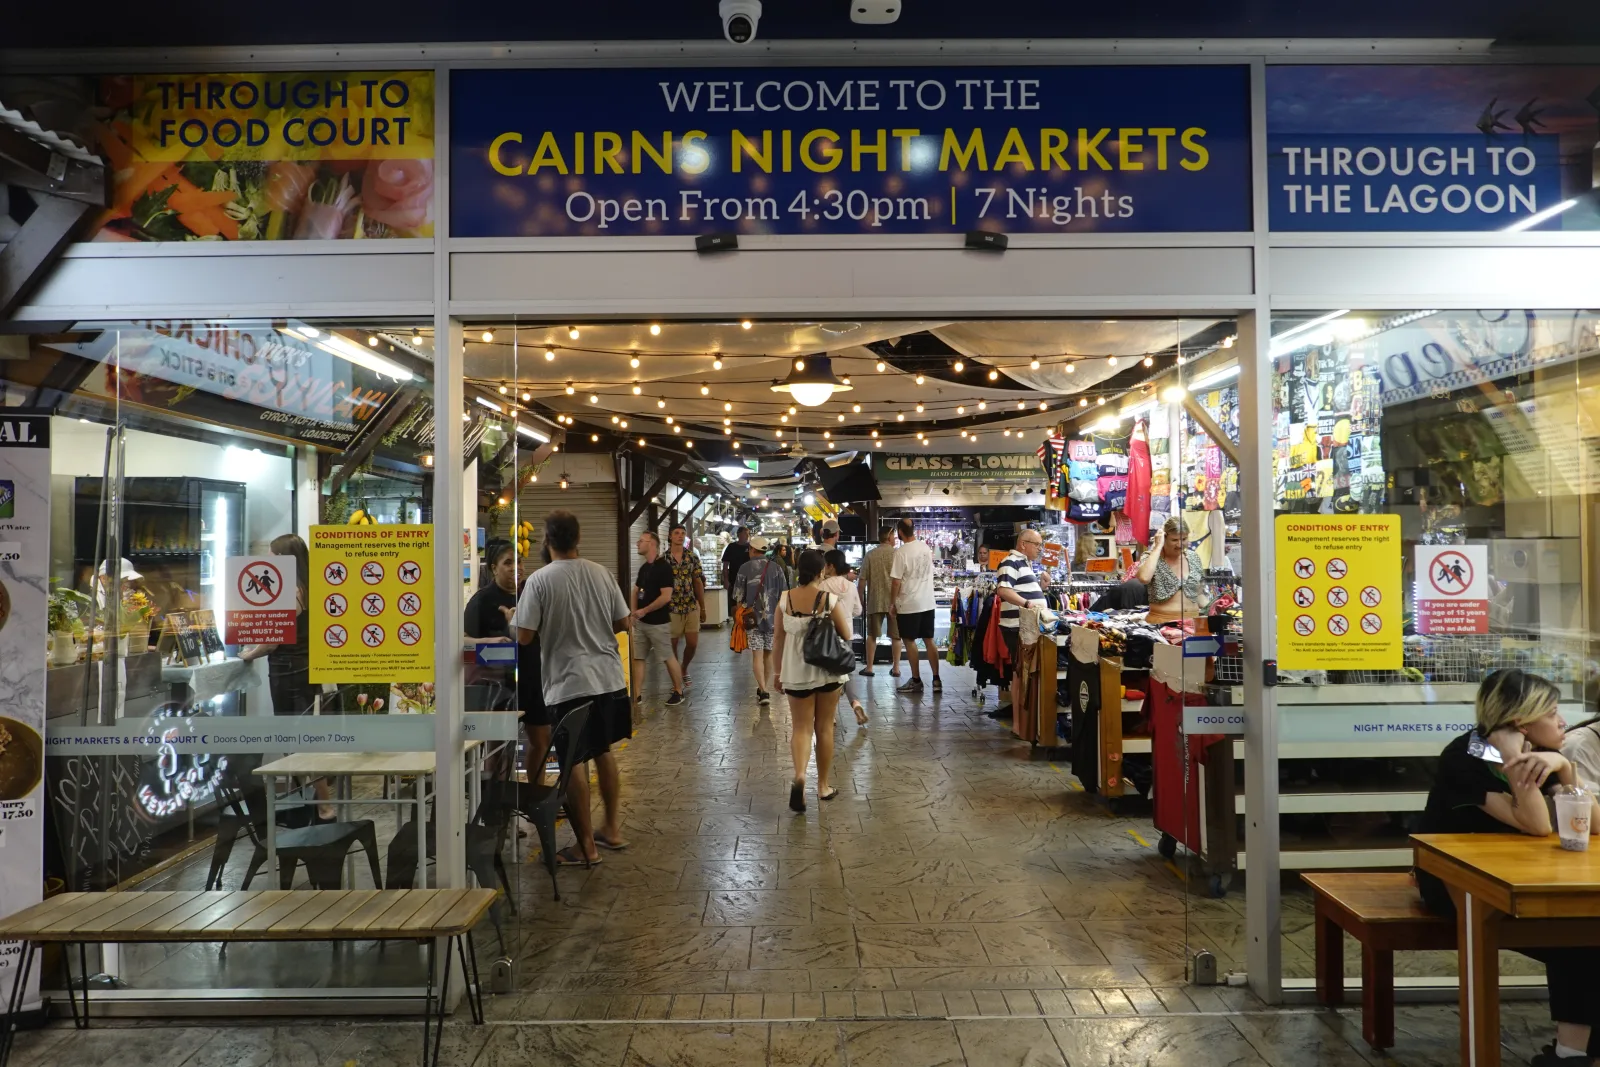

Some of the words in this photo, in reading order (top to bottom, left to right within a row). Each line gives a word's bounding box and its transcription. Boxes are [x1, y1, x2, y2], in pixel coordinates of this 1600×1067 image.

[156, 80, 349, 110] THROUGH
[361, 79, 411, 109] TO
[658, 80, 881, 113] WELCOME
[888, 79, 947, 112] TO
[955, 79, 1041, 111] THE
[159, 118, 270, 148] FOOD
[282, 117, 412, 147] COURT
[487, 129, 711, 177] CAIRNS
[730, 128, 920, 174] NIGHT
[938, 126, 1211, 172] MARKETS
[1282, 146, 1476, 177] THROUGH
[1485, 146, 1537, 176] TO
[1283, 184, 1351, 214] THE
[1363, 184, 1538, 215] LAGOON
[565, 190, 668, 229] Open
[678, 190, 780, 221] From
[787, 188, 932, 227] 4:30pm
[974, 188, 997, 218] 7
[1005, 186, 1135, 225] Nights
[259, 410, 291, 423] GYROS
[332, 433, 354, 443] CHIPS
[885, 456, 954, 470] GLASS
[1286, 524, 1343, 532] CONDITIONS
[1345, 524, 1357, 532] OF
[1360, 524, 1390, 532] ENTRY
[315, 531, 378, 539] CONDITIONS
[380, 531, 393, 539] OF
[396, 530, 430, 538] ENTRY
[1374, 535, 1390, 543] right
[315, 542, 363, 551] Management
[398, 541, 410, 549] the
[412, 540, 430, 550] right
[1345, 544, 1363, 552] entry
[345, 550, 353, 558] to
[354, 550, 378, 558] refuse
[380, 551, 399, 559] entry
[268, 611, 288, 619] under
[1197, 716, 1225, 724] FOOD
[1353, 723, 1385, 732] NIGHT
[1387, 723, 1434, 732] MARKETS
[1435, 723, 1442, 731] &
[1445, 722, 1475, 732] FOOD
[44, 737, 72, 745] NIGHT
[74, 736, 121, 745] MARKETS
[123, 736, 130, 744] &
[132, 736, 161, 744] FOOD
[165, 736, 198, 744] COURT
[213, 735, 238, 744] Doors
[239, 734, 263, 746] Open
[264, 735, 272, 743] at
[273, 734, 297, 743] 10am
[302, 733, 327, 745] Open
[327, 733, 333, 742] 7
[334, 733, 355, 745] Days
[2, 809, 34, 820] 17.50
